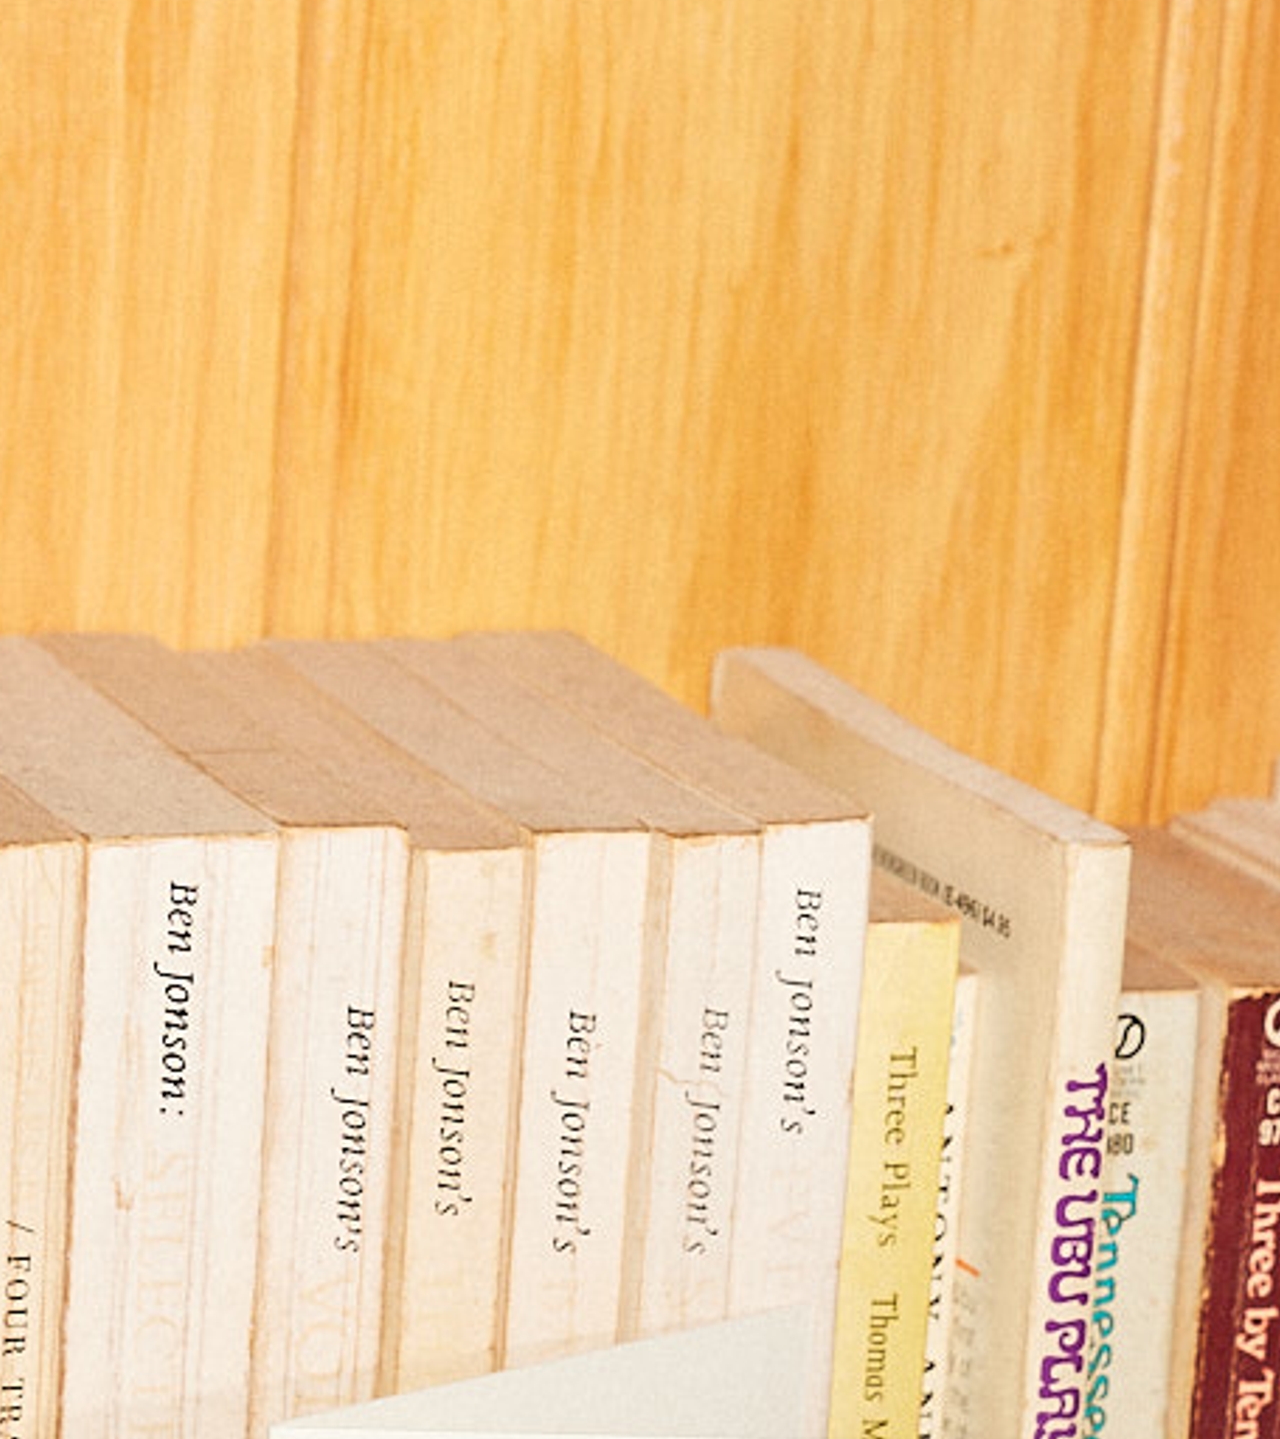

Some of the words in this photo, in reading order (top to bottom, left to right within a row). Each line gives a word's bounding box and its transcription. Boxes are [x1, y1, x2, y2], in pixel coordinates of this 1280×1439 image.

[167, 883, 200, 954] Ben
[794, 888, 823, 957] Ben
[154, 963, 195, 1116] Jonson:
[347, 1006, 376, 1074] Ben
[445, 981, 476, 1048] Ben
[566, 1011, 597, 1079] Ben
[700, 1009, 730, 1072] Ben
[776, 970, 816, 1135] Jonson's
[431, 1058, 472, 1217] Jonson's
[885, 1046, 918, 1145] Three
[1059, 1063, 1109, 1181] THE
[332, 1089, 372, 1253] Jonson's
[551, 1091, 591, 1254] Jonson's
[684, 1092, 721, 1255] Jonson's
[870, 1162, 910, 1248] Plays
[1048, 1190, 1098, 1305] UBU
[0, 1254, 32, 1359] FOUR
[863, 1295, 899, 1401] Thomas
[1238, 1308, 1278, 1359] by
